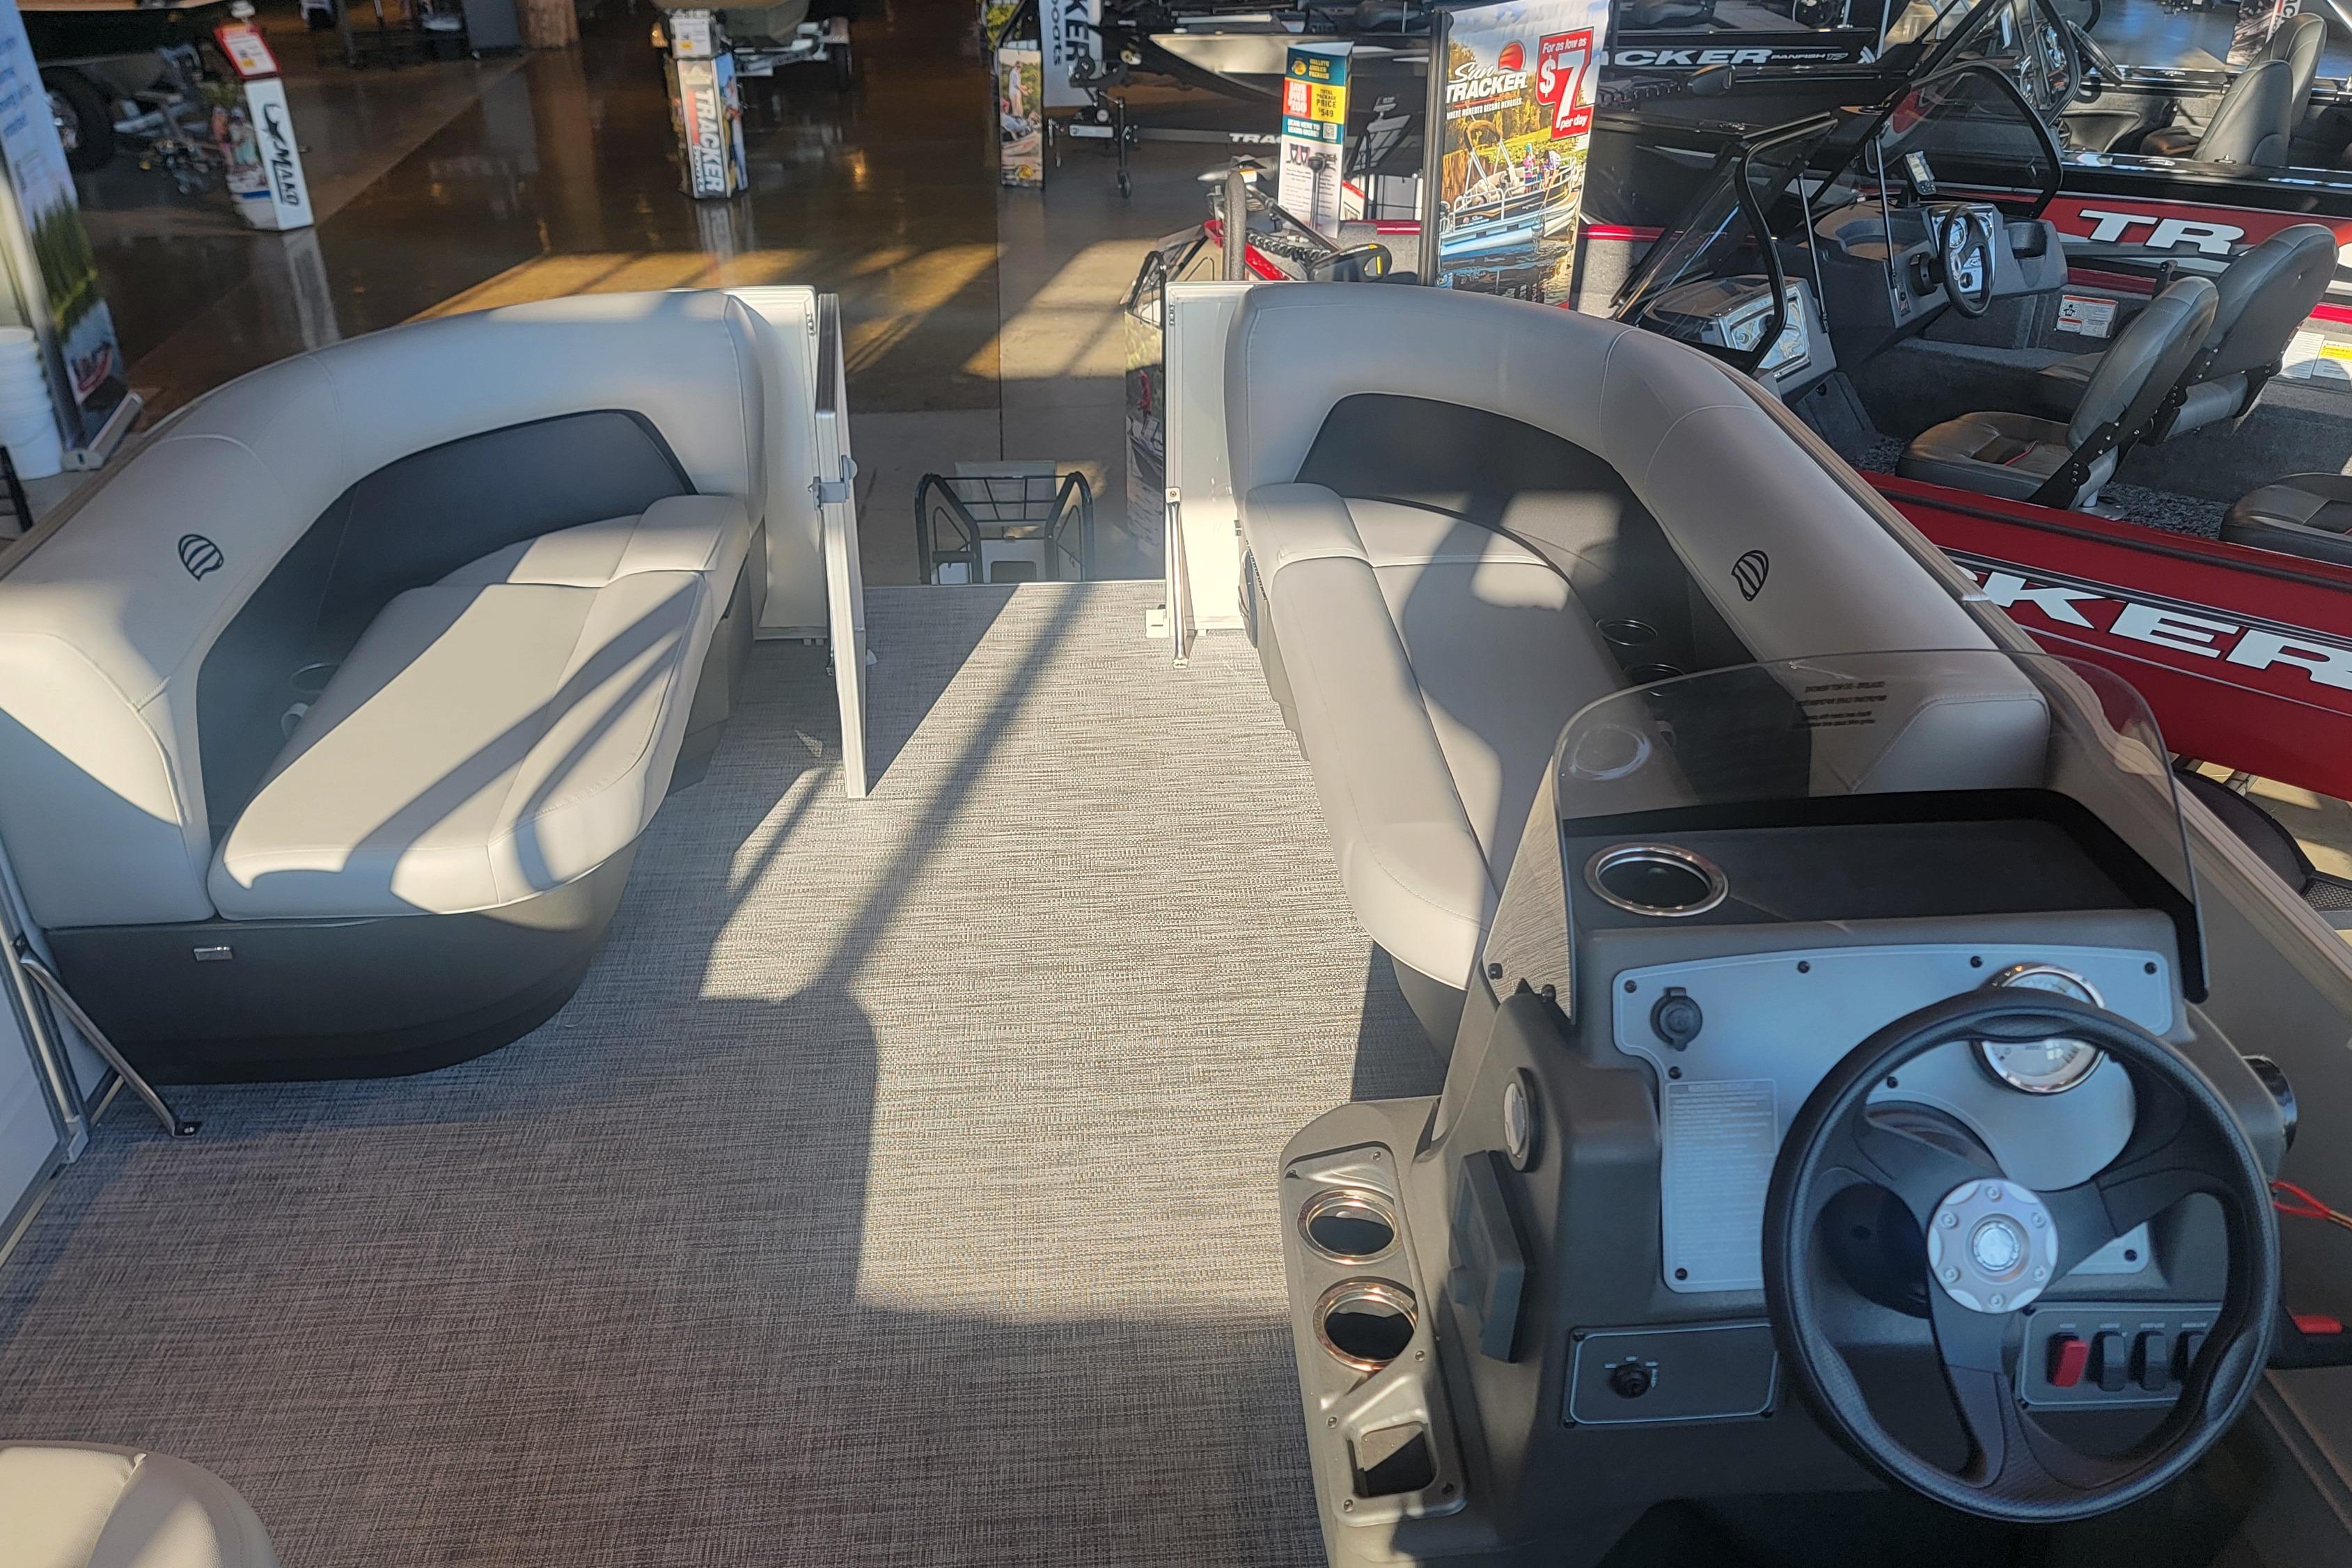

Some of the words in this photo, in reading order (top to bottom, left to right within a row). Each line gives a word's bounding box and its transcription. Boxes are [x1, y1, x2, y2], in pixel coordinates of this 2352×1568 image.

[1051, 0, 1061, 65] oats
[1542, 42, 1555, 54] For
[1555, 40, 1564, 51] as
[1565, 38, 1577, 50] low
[1578, 38, 1587, 47] as
[1449, 61, 1495, 83] Sun
[1446, 71, 1528, 104] TRACKER
[1316, 98, 1337, 109] PRICE
[1559, 116, 1572, 131] per
[1572, 114, 1588, 129] day
[695, 89, 726, 193] TRACKER
[1958, 565, 2352, 691] KER
